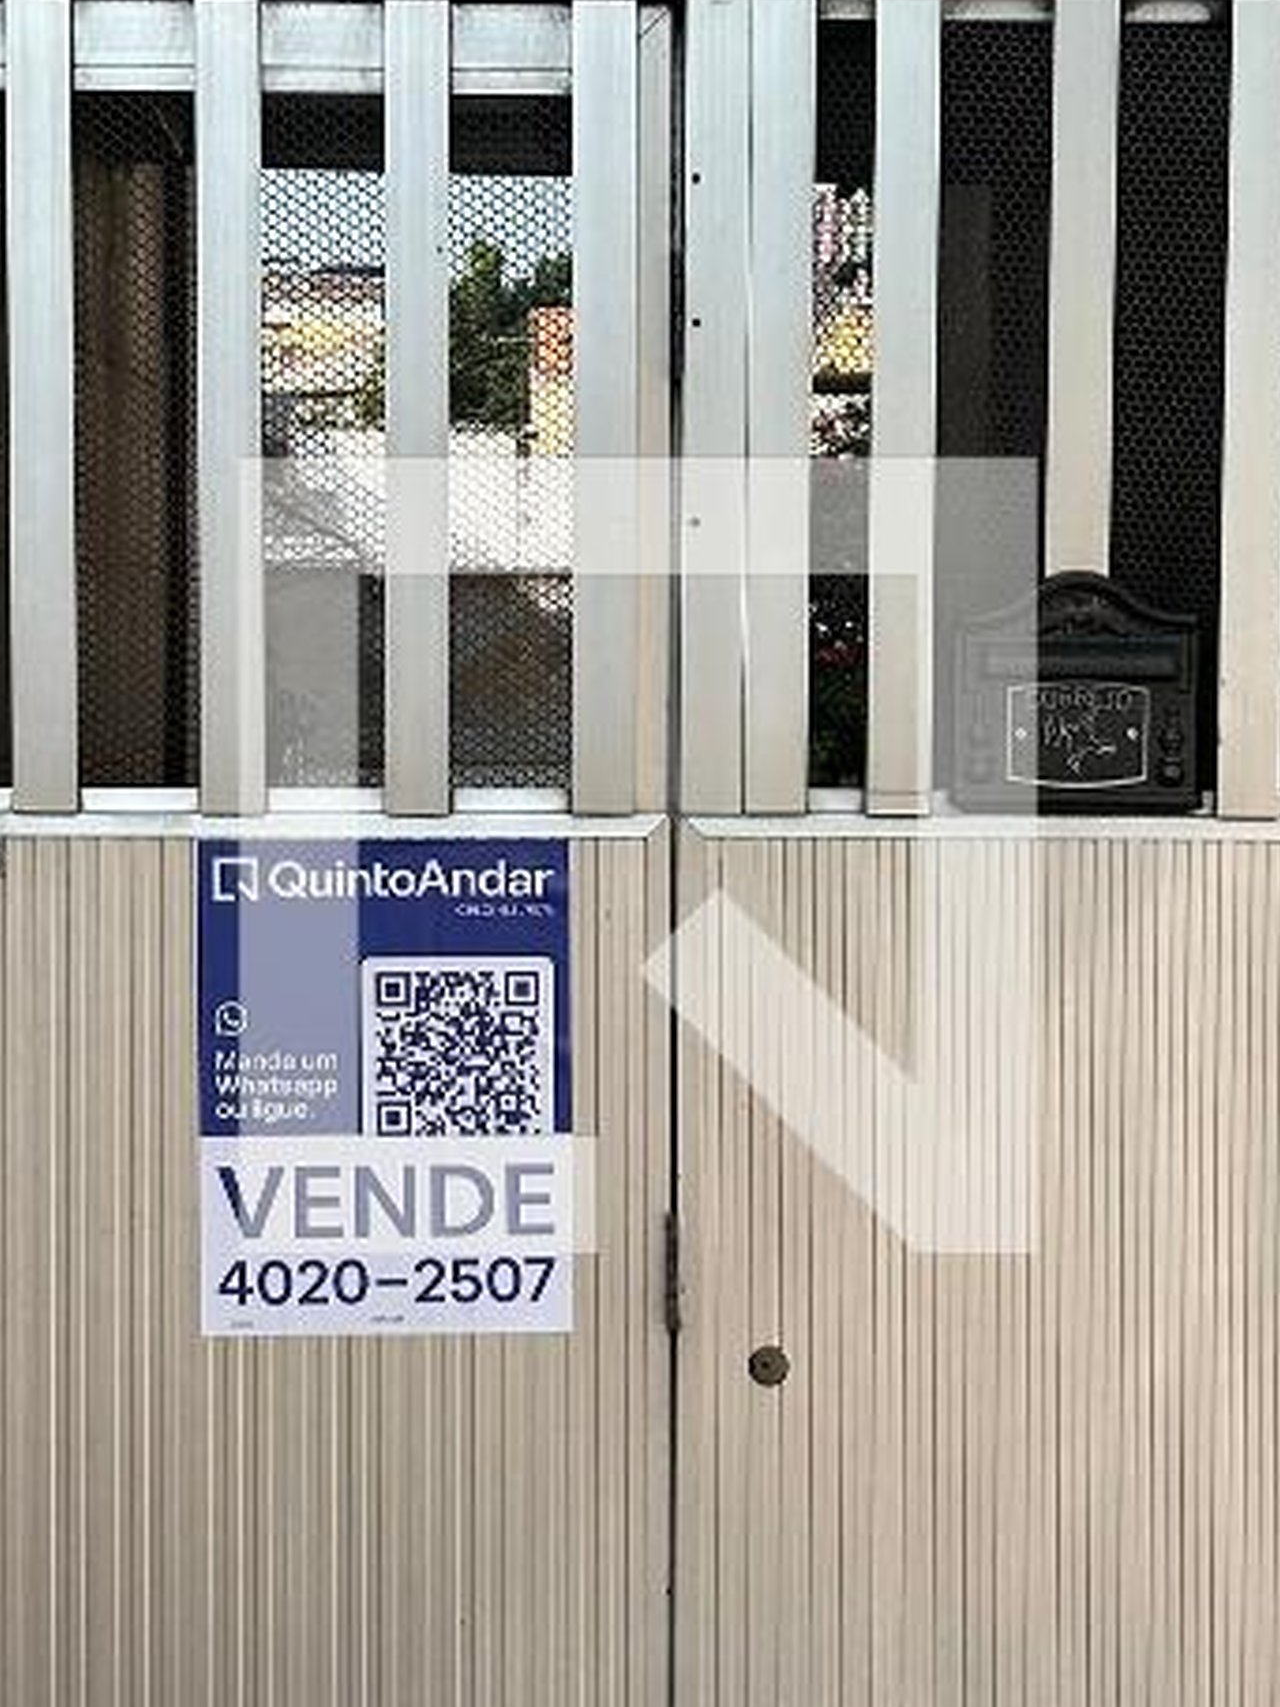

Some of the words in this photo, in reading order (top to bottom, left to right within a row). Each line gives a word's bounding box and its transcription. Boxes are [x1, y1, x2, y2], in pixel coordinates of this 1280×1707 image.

[268, 858, 555, 898] QuintoAndar
[215, 1163, 556, 1239] VENDE
[217, 1256, 556, 1306] 4020-2507
